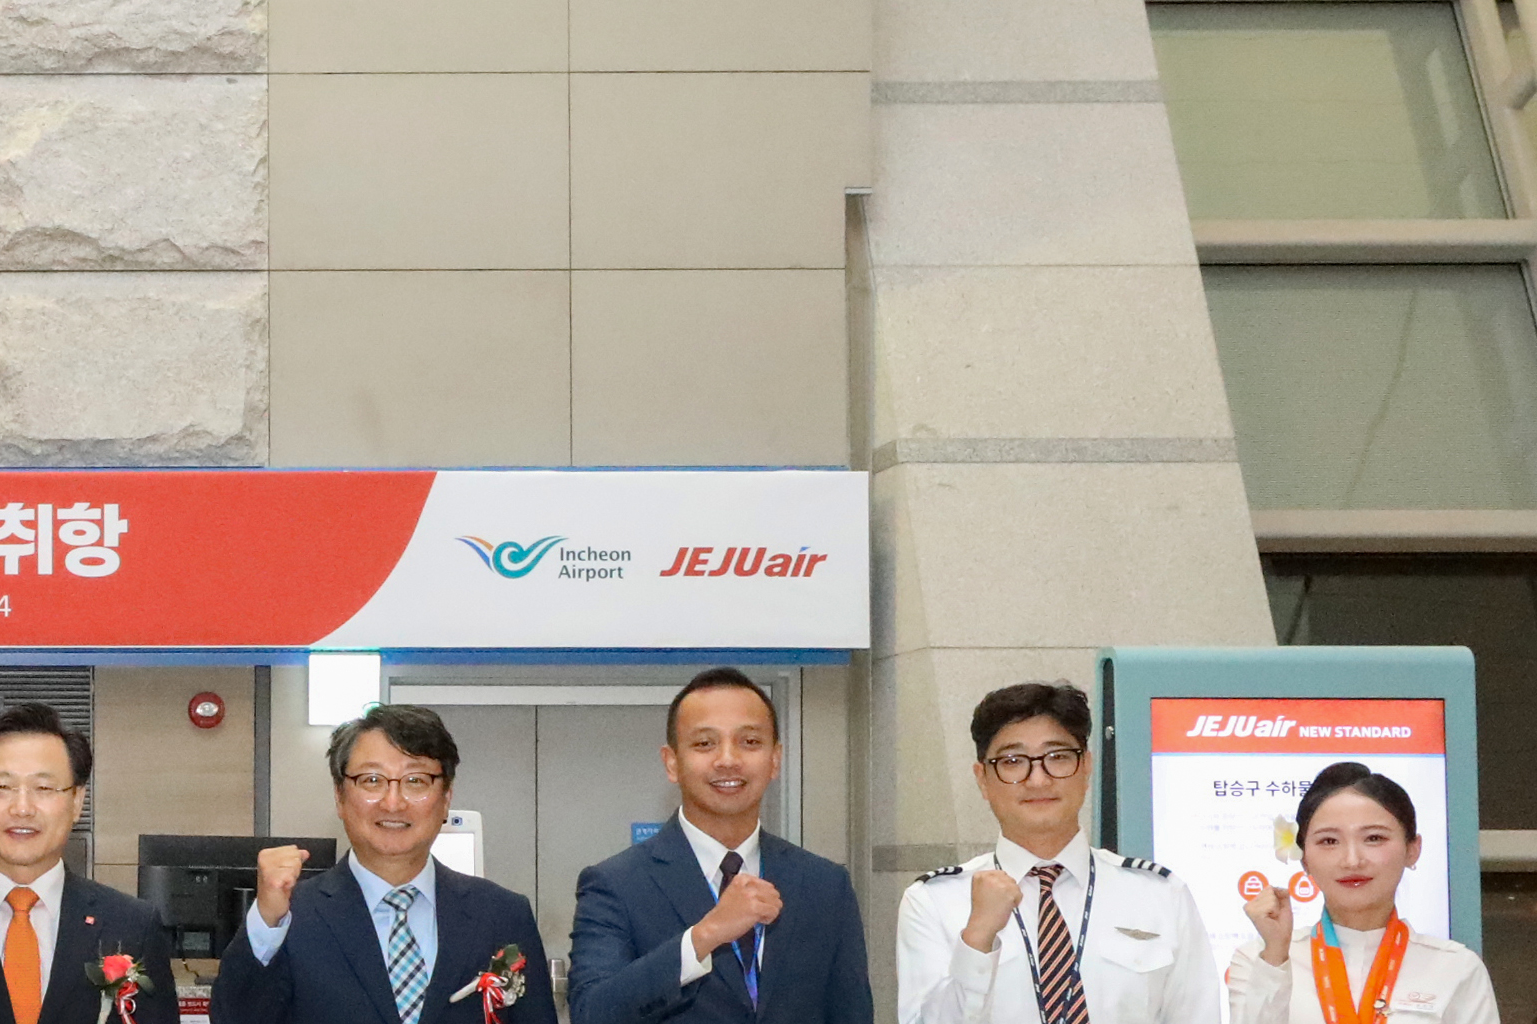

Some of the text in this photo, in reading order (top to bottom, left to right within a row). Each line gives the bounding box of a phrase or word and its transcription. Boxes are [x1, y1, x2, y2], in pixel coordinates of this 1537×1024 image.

[559, 546, 632, 562] Incheon
[558, 565, 624, 582] Airport
[1299, 726, 1332, 738] NEW
[1334, 726, 1412, 739] STANDARD
[1213, 780, 1260, 797] 탑승구
